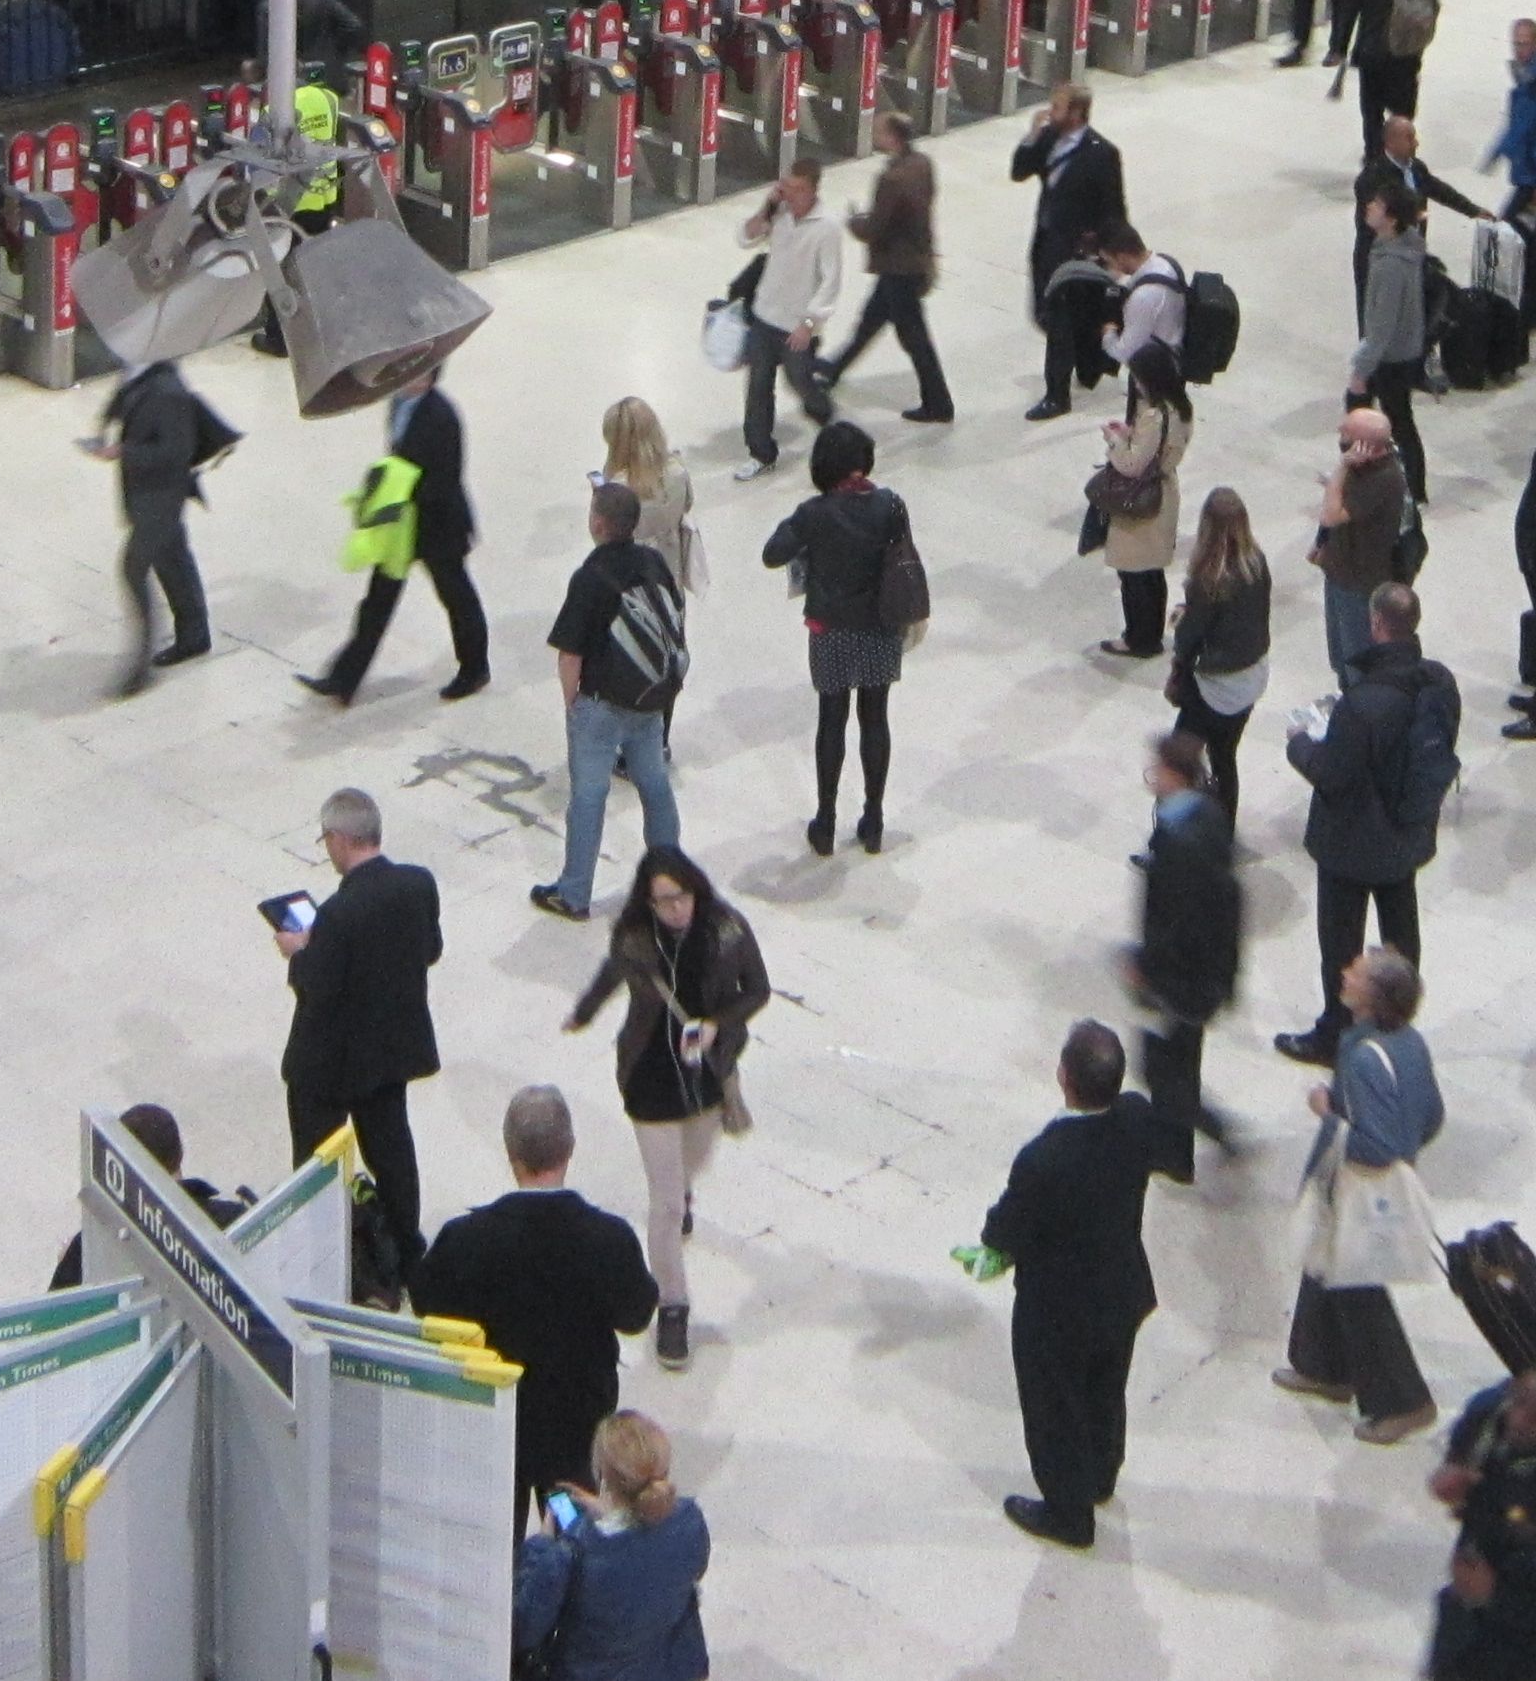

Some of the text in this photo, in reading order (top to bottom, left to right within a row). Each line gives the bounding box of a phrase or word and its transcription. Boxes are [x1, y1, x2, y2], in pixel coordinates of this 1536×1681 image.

[137, 1188, 249, 1339] Information
[12, 1355, 61, 1383] Times
[331, 1360, 411, 1386] ain Times
